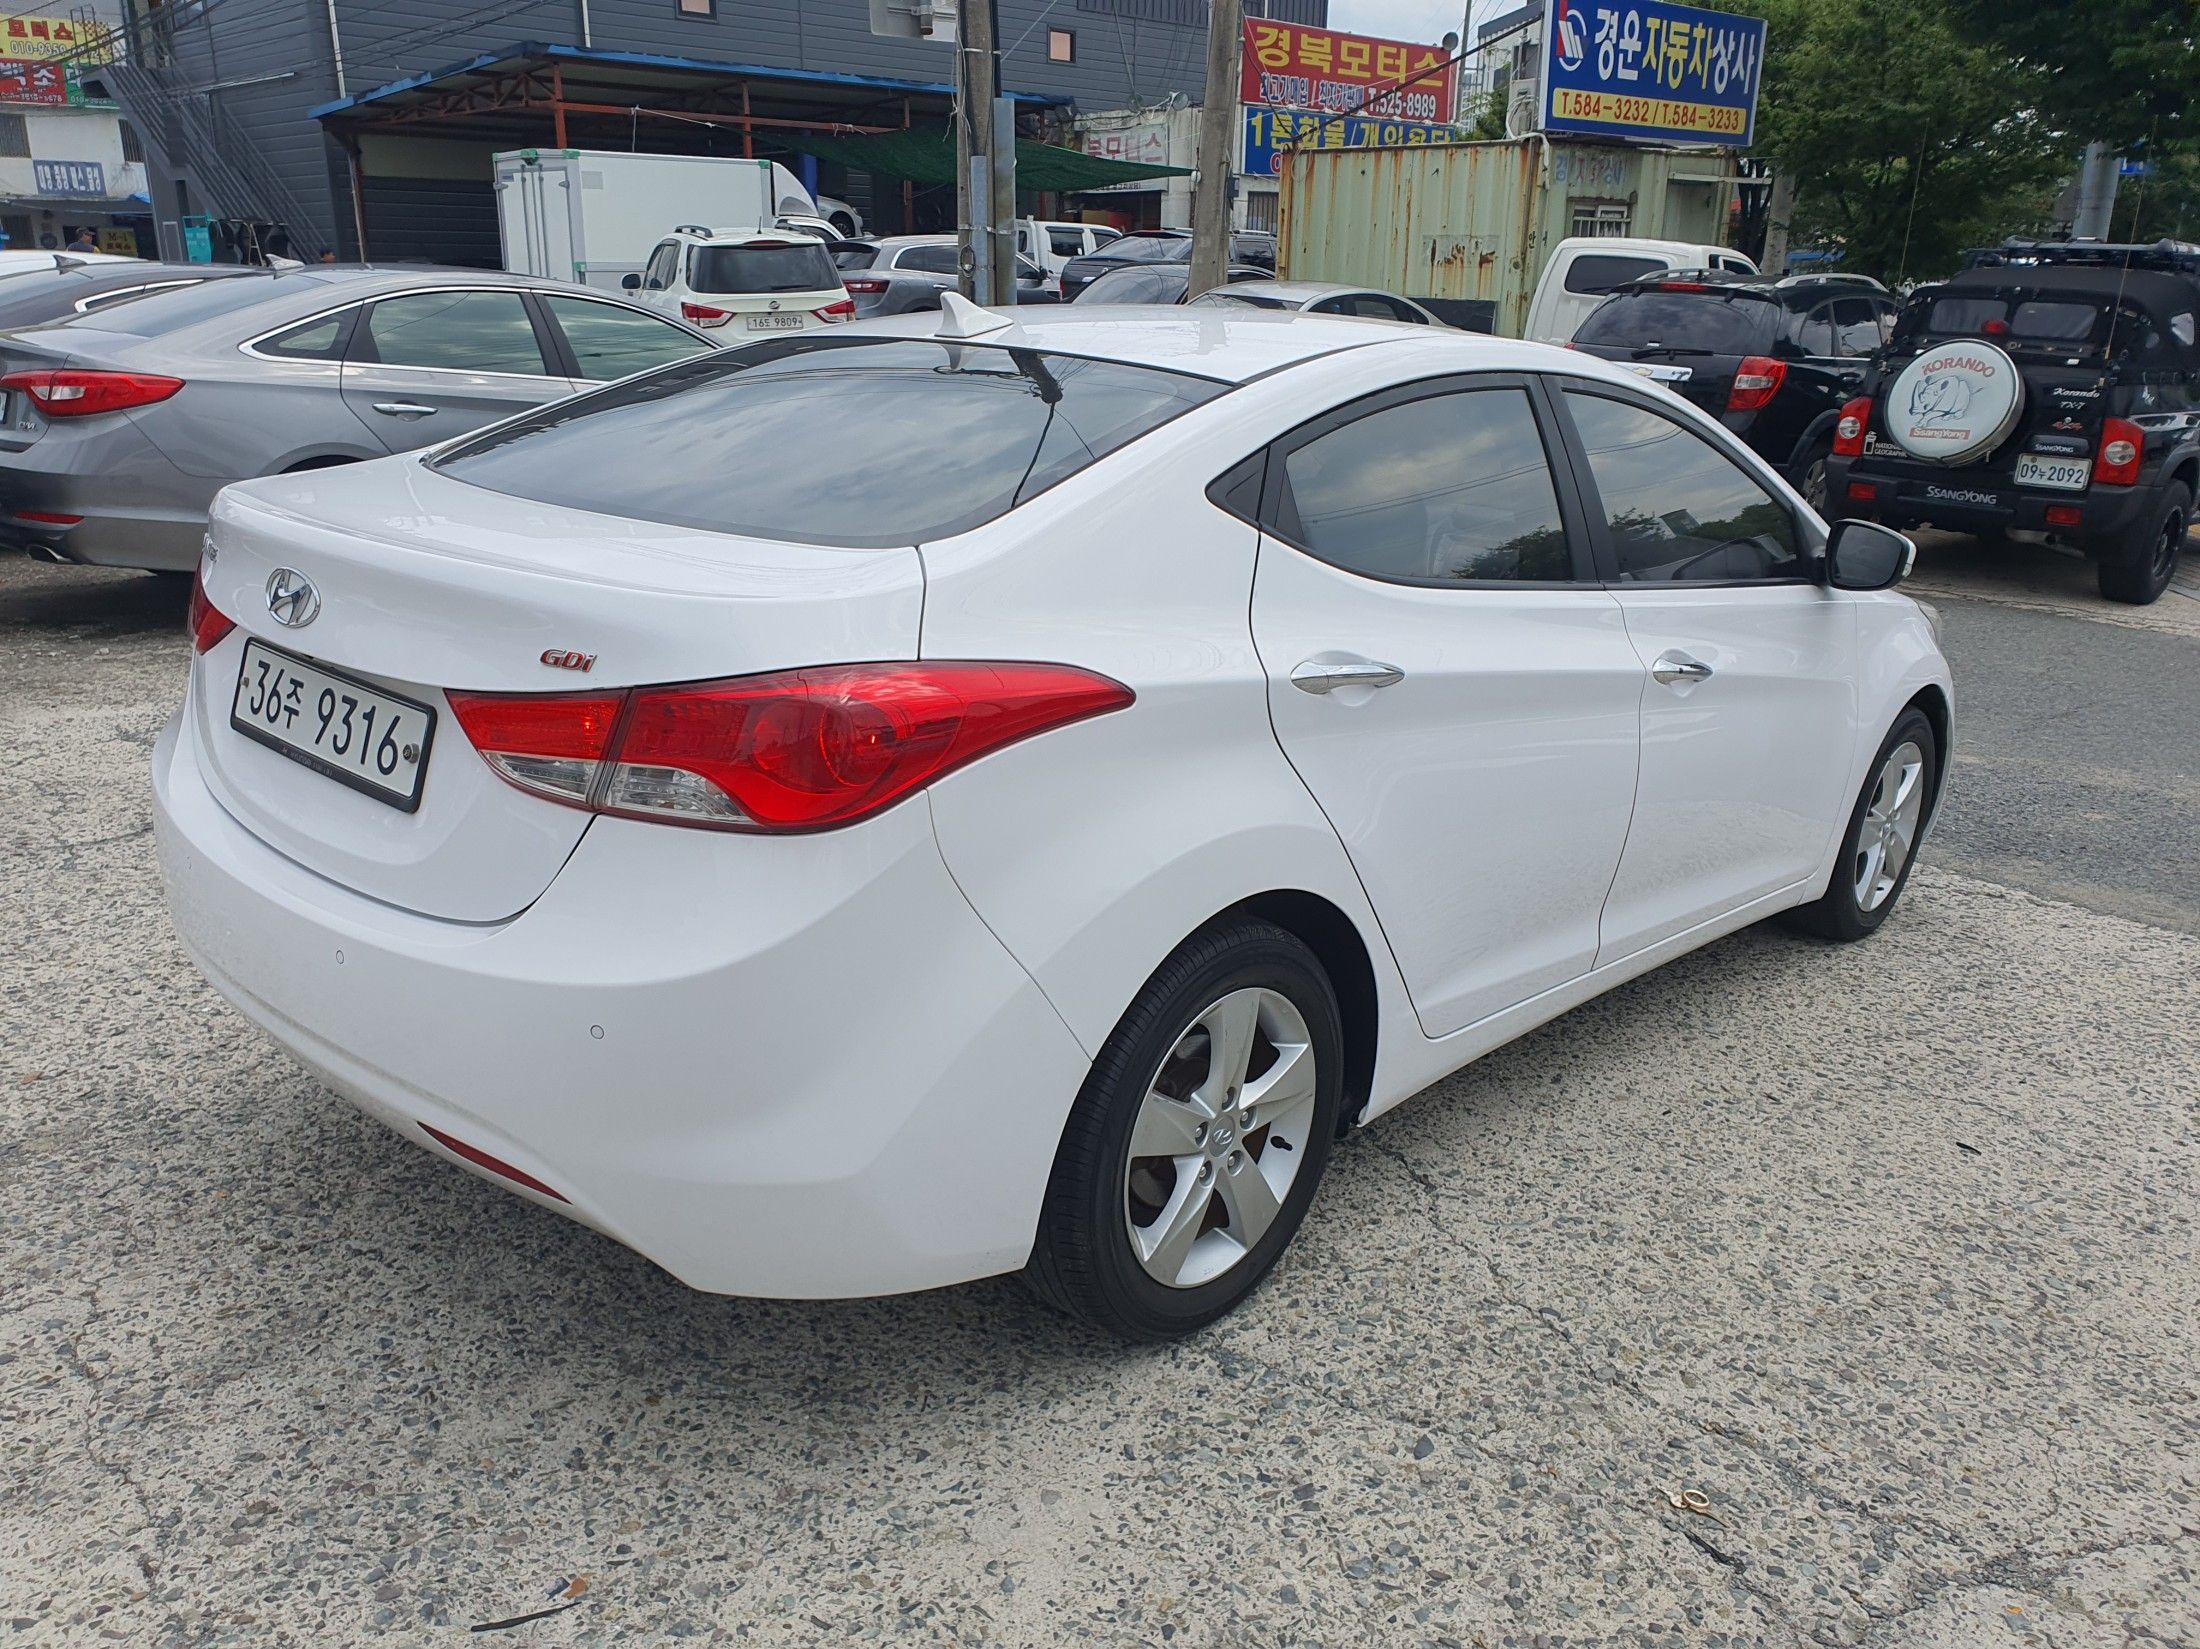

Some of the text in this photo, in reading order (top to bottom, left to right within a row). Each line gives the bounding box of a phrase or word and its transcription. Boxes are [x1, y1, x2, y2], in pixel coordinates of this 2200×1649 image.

[1256, 26, 1443, 87] 경북모터스
[1594, 8, 1755, 94] 경운자동차상사
[1368, 87, 1436, 119] T.525-8989
[1562, 92, 1649, 122] T.584-3232
[1662, 104, 1739, 131] T.584-3233
[774, 316, 798, 327] 9809
[1921, 356, 1996, 378] KORANDO
[2053, 387, 2100, 398] Korando
[539, 648, 598, 673] GDi
[250, 659, 305, 730] 36주
[316, 687, 401, 776] 9316
